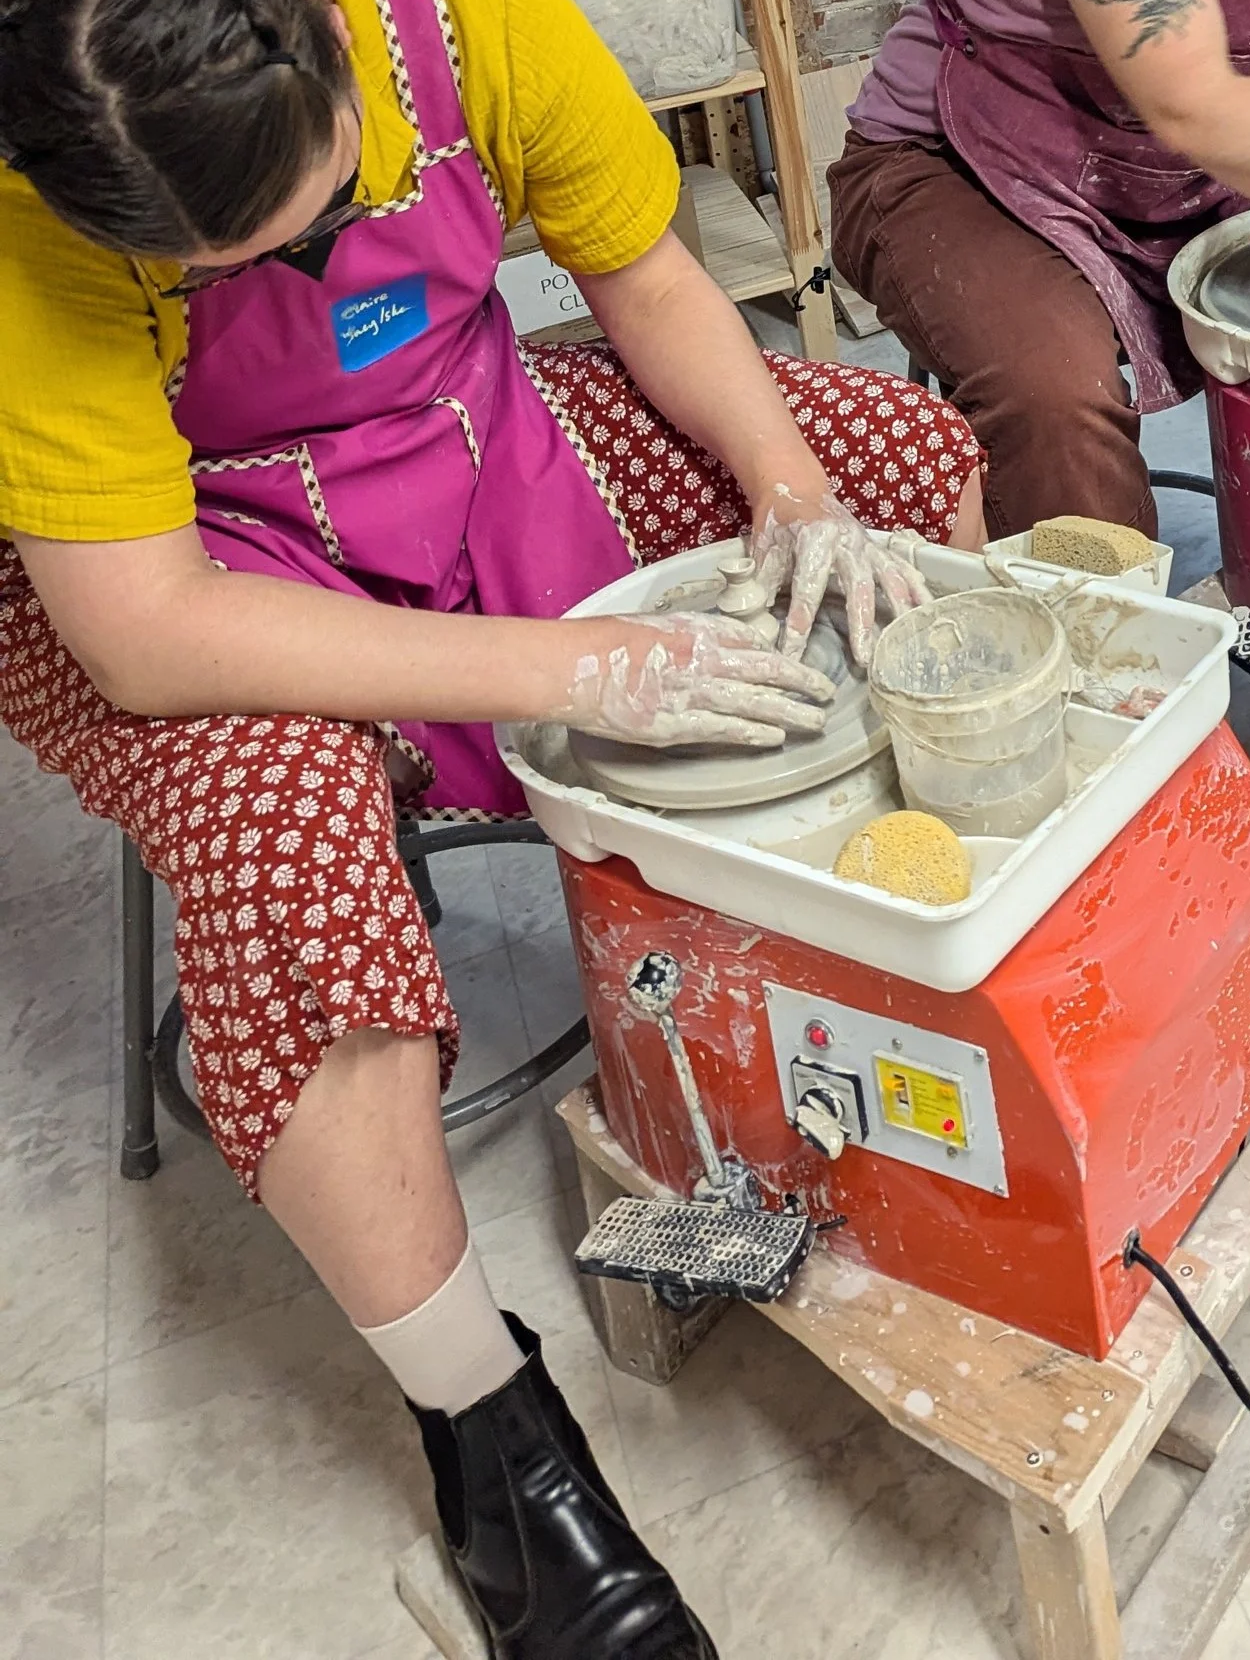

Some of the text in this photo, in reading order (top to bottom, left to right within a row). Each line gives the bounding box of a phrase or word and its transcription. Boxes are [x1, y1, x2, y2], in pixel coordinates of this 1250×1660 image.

[540, 273, 569, 294] PO
[340, 292, 388, 320] Claire
[560, 294, 583, 311] CL
